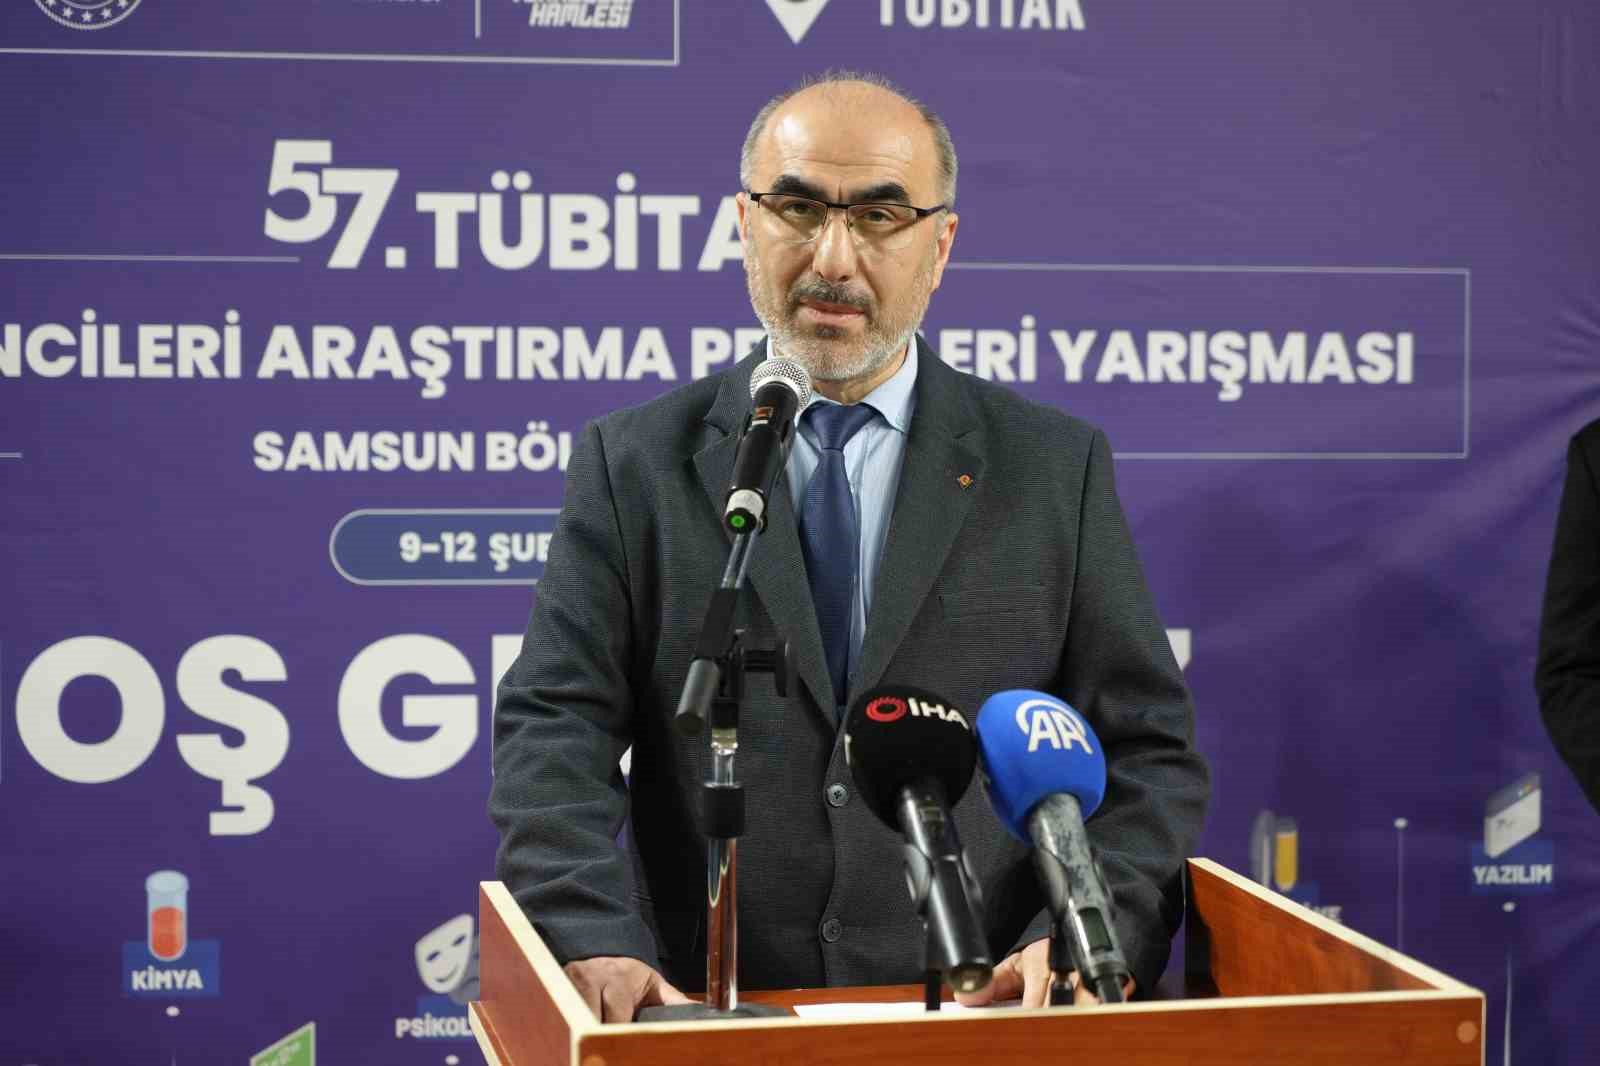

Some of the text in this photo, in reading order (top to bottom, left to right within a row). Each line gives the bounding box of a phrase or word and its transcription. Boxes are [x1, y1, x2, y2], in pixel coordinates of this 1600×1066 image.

[264, 140, 744, 271] 57. TÜBİTA
[257, 325, 677, 399] ARAŞTIRMA
[1049, 329, 1414, 402] YARIŞMASI
[253, 431, 475, 472] SAMSUN
[1473, 864, 1552, 885] YAZILIM
[131, 966, 204, 991] KİMYA
[395, 1012, 472, 1038] PSİKOL
